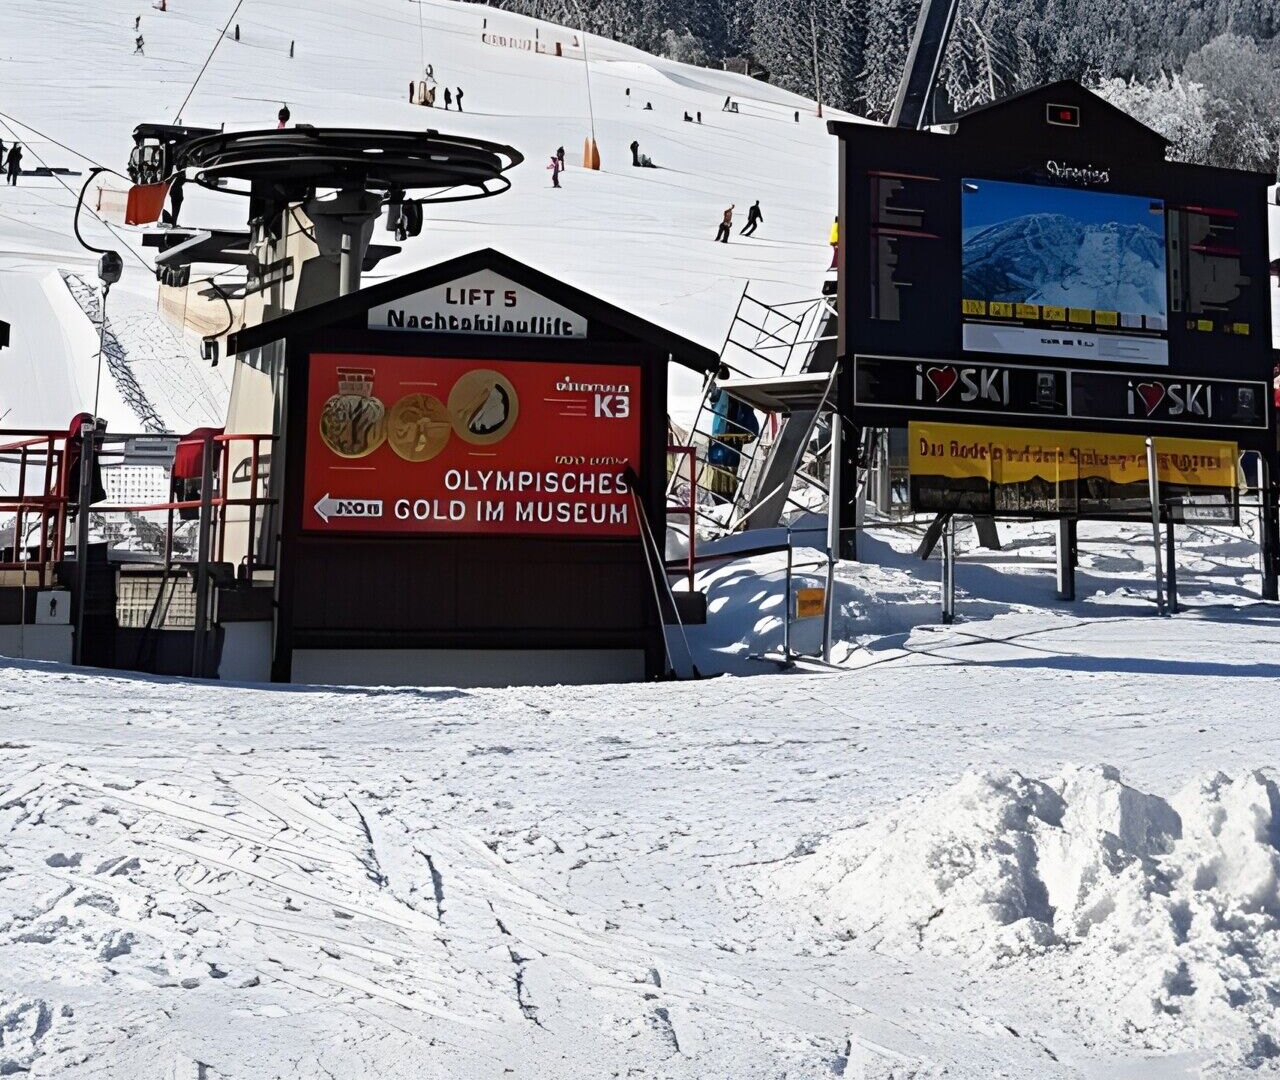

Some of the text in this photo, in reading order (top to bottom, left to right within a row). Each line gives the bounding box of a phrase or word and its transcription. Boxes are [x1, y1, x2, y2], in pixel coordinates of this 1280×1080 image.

[445, 287, 517, 308] LIFT 5
[960, 368, 1010, 407] SKI
[594, 393, 630, 418] K3
[1167, 384, 1212, 418] SKI
[444, 469, 629, 494] OLYMPISCHES
[394, 499, 629, 524] GOLD IM MUSEUM
